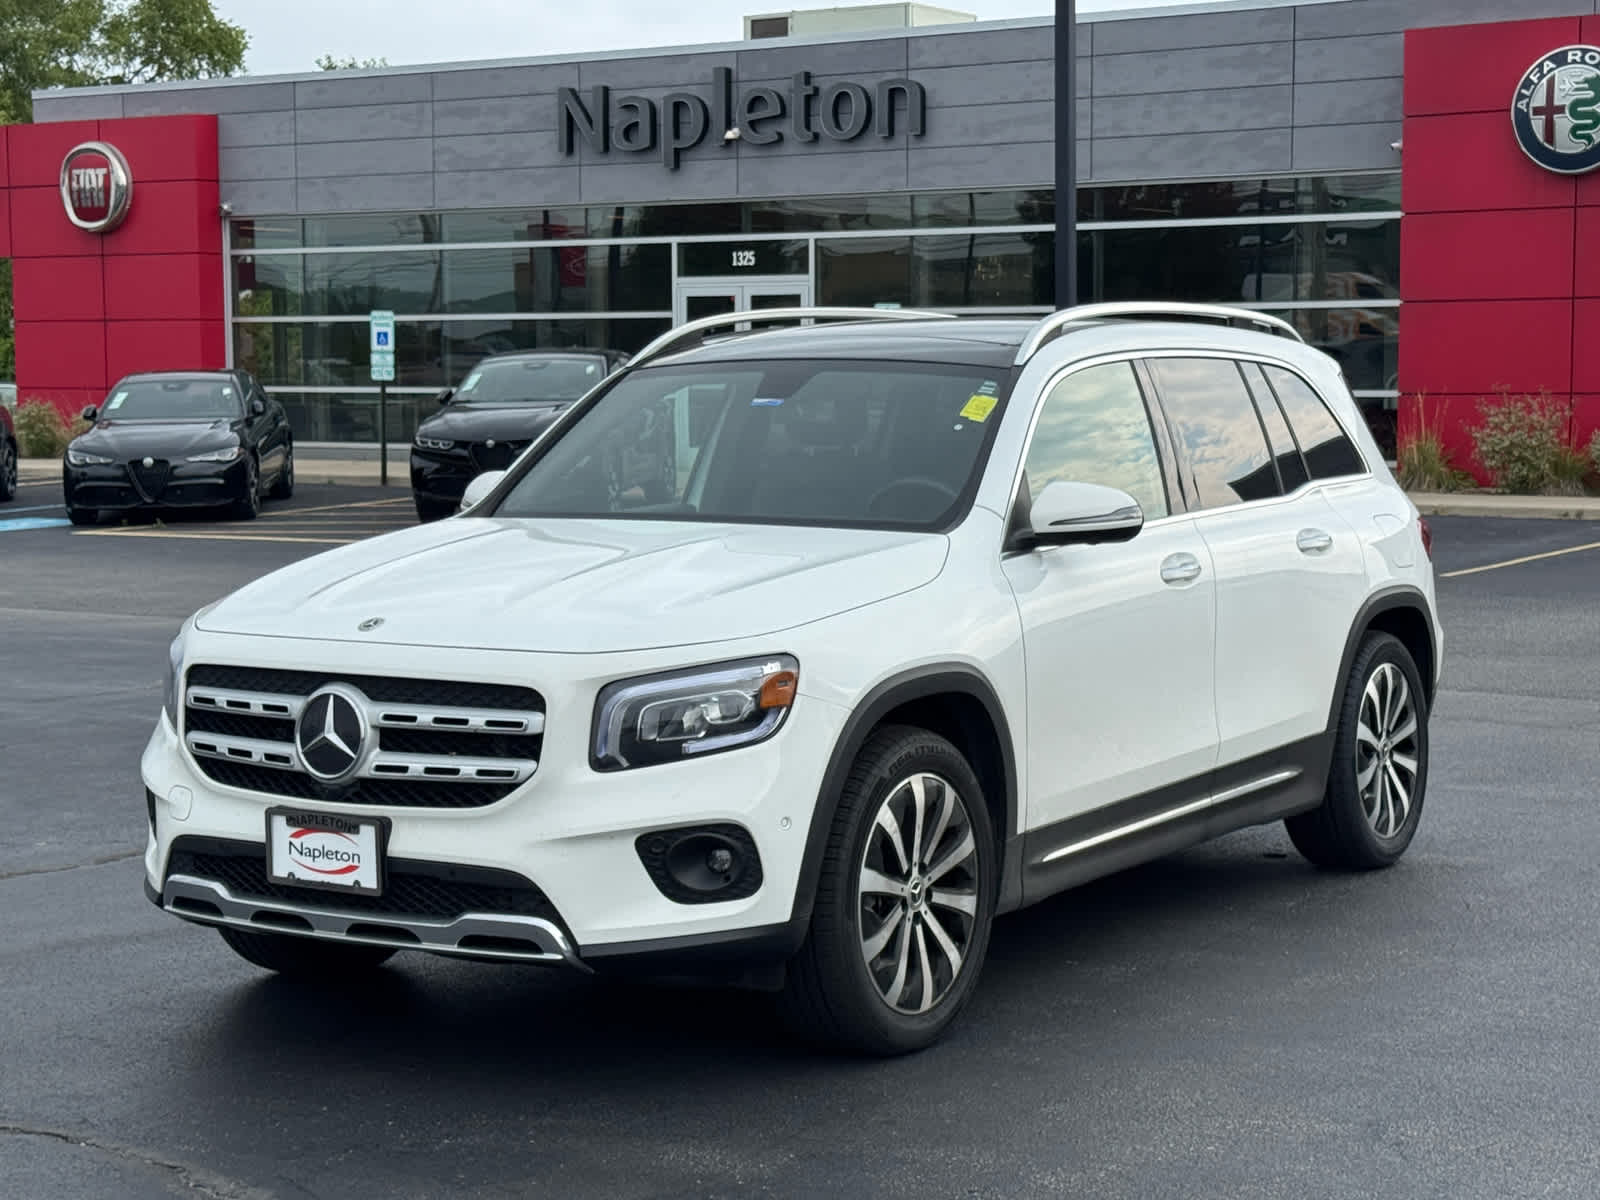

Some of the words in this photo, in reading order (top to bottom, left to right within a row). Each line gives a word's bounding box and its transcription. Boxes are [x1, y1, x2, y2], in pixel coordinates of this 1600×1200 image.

[1516, 60, 1556, 112] ALFA
[558, 66, 926, 170] Napleton
[72, 168, 107, 208] FIAT
[732, 250, 756, 266] 1325
[288, 840, 361, 864] Napleton
